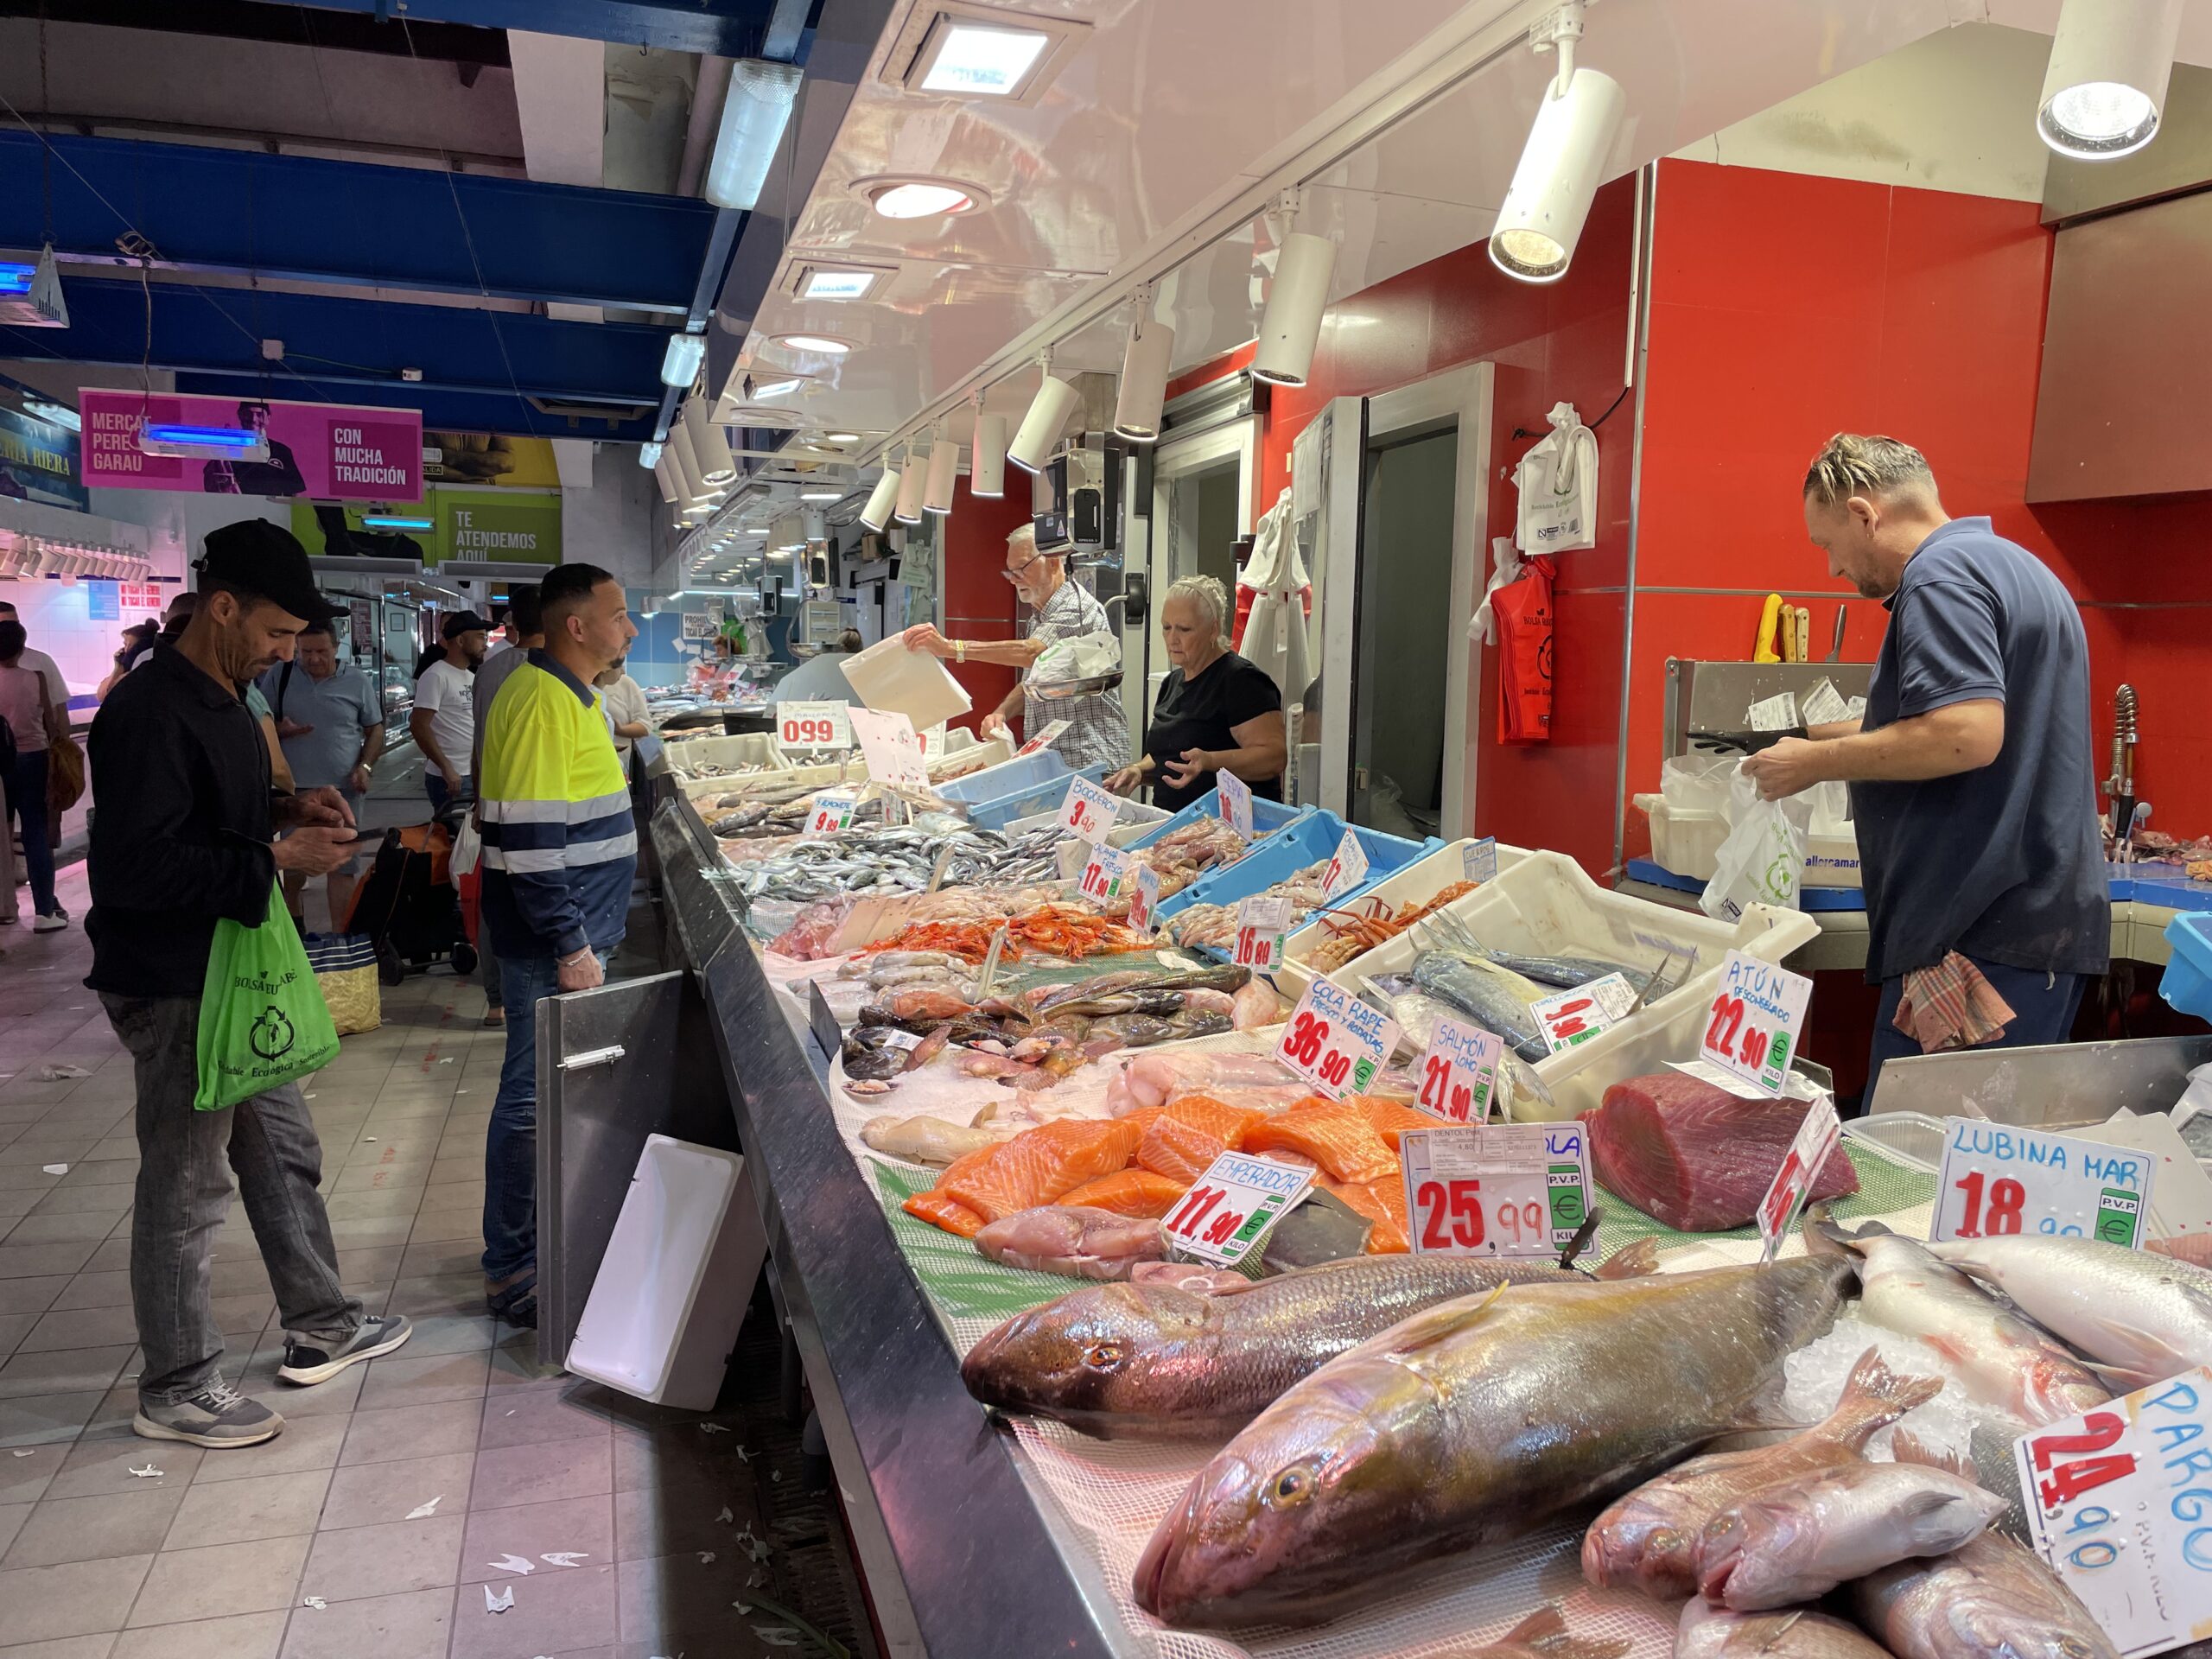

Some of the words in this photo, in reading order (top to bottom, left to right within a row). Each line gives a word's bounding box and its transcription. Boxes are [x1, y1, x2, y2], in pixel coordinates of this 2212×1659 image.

[93, 433, 130, 450] PERE
[334, 428, 361, 445] CON
[33, 447, 70, 476] RIERA
[93, 454, 143, 472] GARAU
[335, 447, 383, 465] MUCHA
[334, 466, 406, 485] TRADICIÓN
[456, 511, 473, 527] TE
[456, 530, 536, 550] ATENDEMOS
[235, 976, 264, 992] BOLSA
[1728, 961, 1785, 1001] ATÚN
[1313, 980, 1344, 1009] COLA
[1348, 1002, 1387, 1036] RAPE
[1311, 996, 1339, 1020] FRESCO
[1348, 1021, 1383, 1053] RODAJAS
[1438, 1024, 1486, 1058] SALMÓN
[1455, 1055, 1478, 1072] LOMO
[1765, 1068, 1780, 1079] KILO
[1953, 1125, 2068, 1170] LUBINA
[2084, 1154, 2139, 1191] MAR
[1213, 1159, 1301, 1195] EMPERADOR
[1549, 1175, 1580, 1185] P.V.P.
[2102, 1198, 2136, 1211] P.V.P.
[1229, 1240, 1245, 1249] KILO
[1556, 1231, 1574, 1240] KIL
